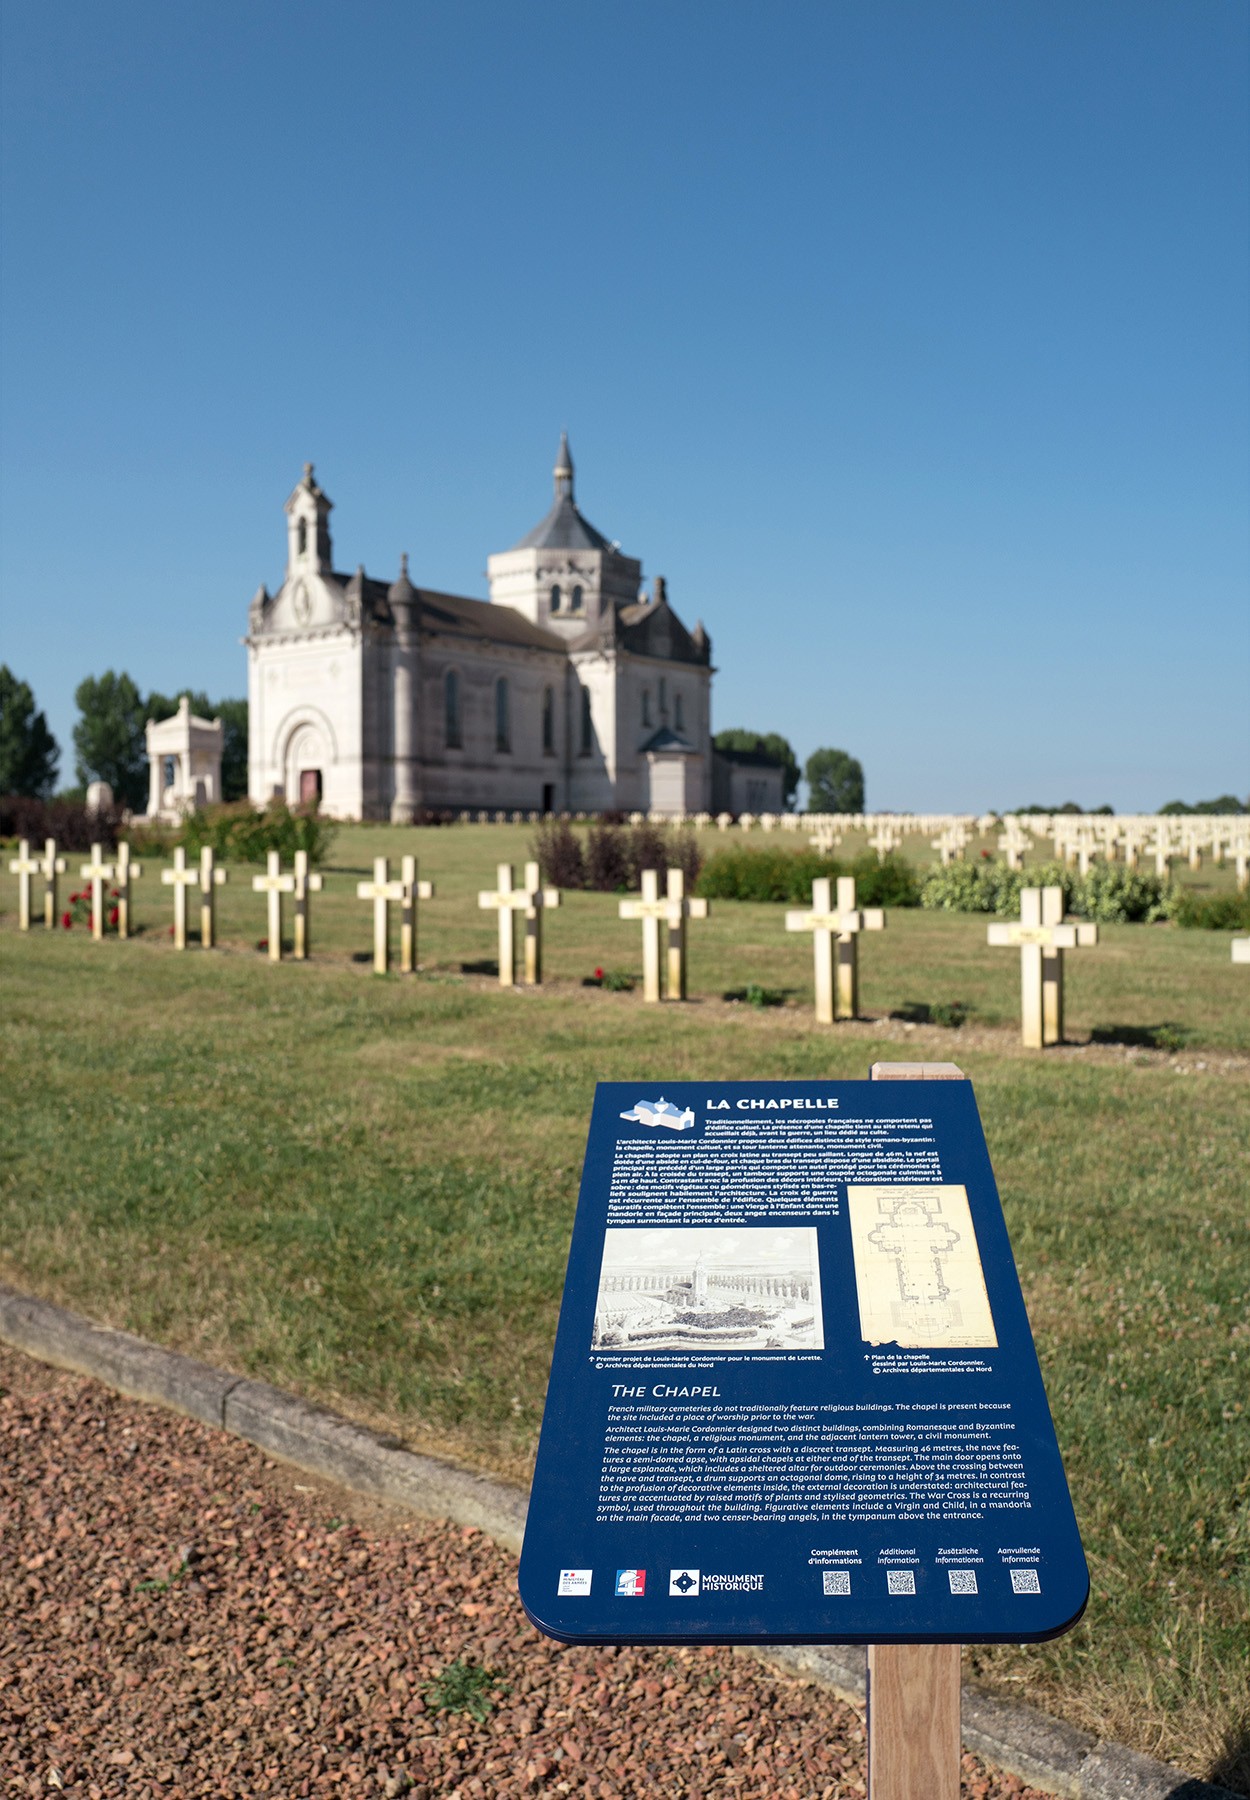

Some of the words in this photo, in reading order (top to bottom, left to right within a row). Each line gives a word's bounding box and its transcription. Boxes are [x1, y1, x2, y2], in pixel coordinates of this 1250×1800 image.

[707, 1099, 731, 1110] LA
[736, 1098, 839, 1110] CHAPELLE
[636, 1405, 668, 1413] military
[740, 1405, 789, 1413] traditionally
[790, 1404, 819, 1412] feature
[820, 1404, 854, 1412] religious
[856, 1404, 894, 1412] buildings.
[911, 1403, 938, 1411] chapel
[706, 1414, 717, 1422] of
[737, 1425, 773, 1434] designed
[822, 1424, 861, 1433] buildings,
[862, 1424, 905, 1432] combining
[906, 1424, 957, 1433] Romanesque
[976, 1423, 1015, 1431] Byzantine
[662, 1435, 692, 1443] chapel,
[701, 1434, 737, 1443] religious
[820, 1434, 857, 1442] adjacent
[650, 1514, 683, 1523] facade,
[722, 1513, 786, 1522] censer-bearing
[788, 1513, 819, 1522] angels,
[848, 1513, 896, 1522] tympanum
[811, 1549, 858, 1557] Complément
[702, 1582, 763, 1592] HISTORIQUE
